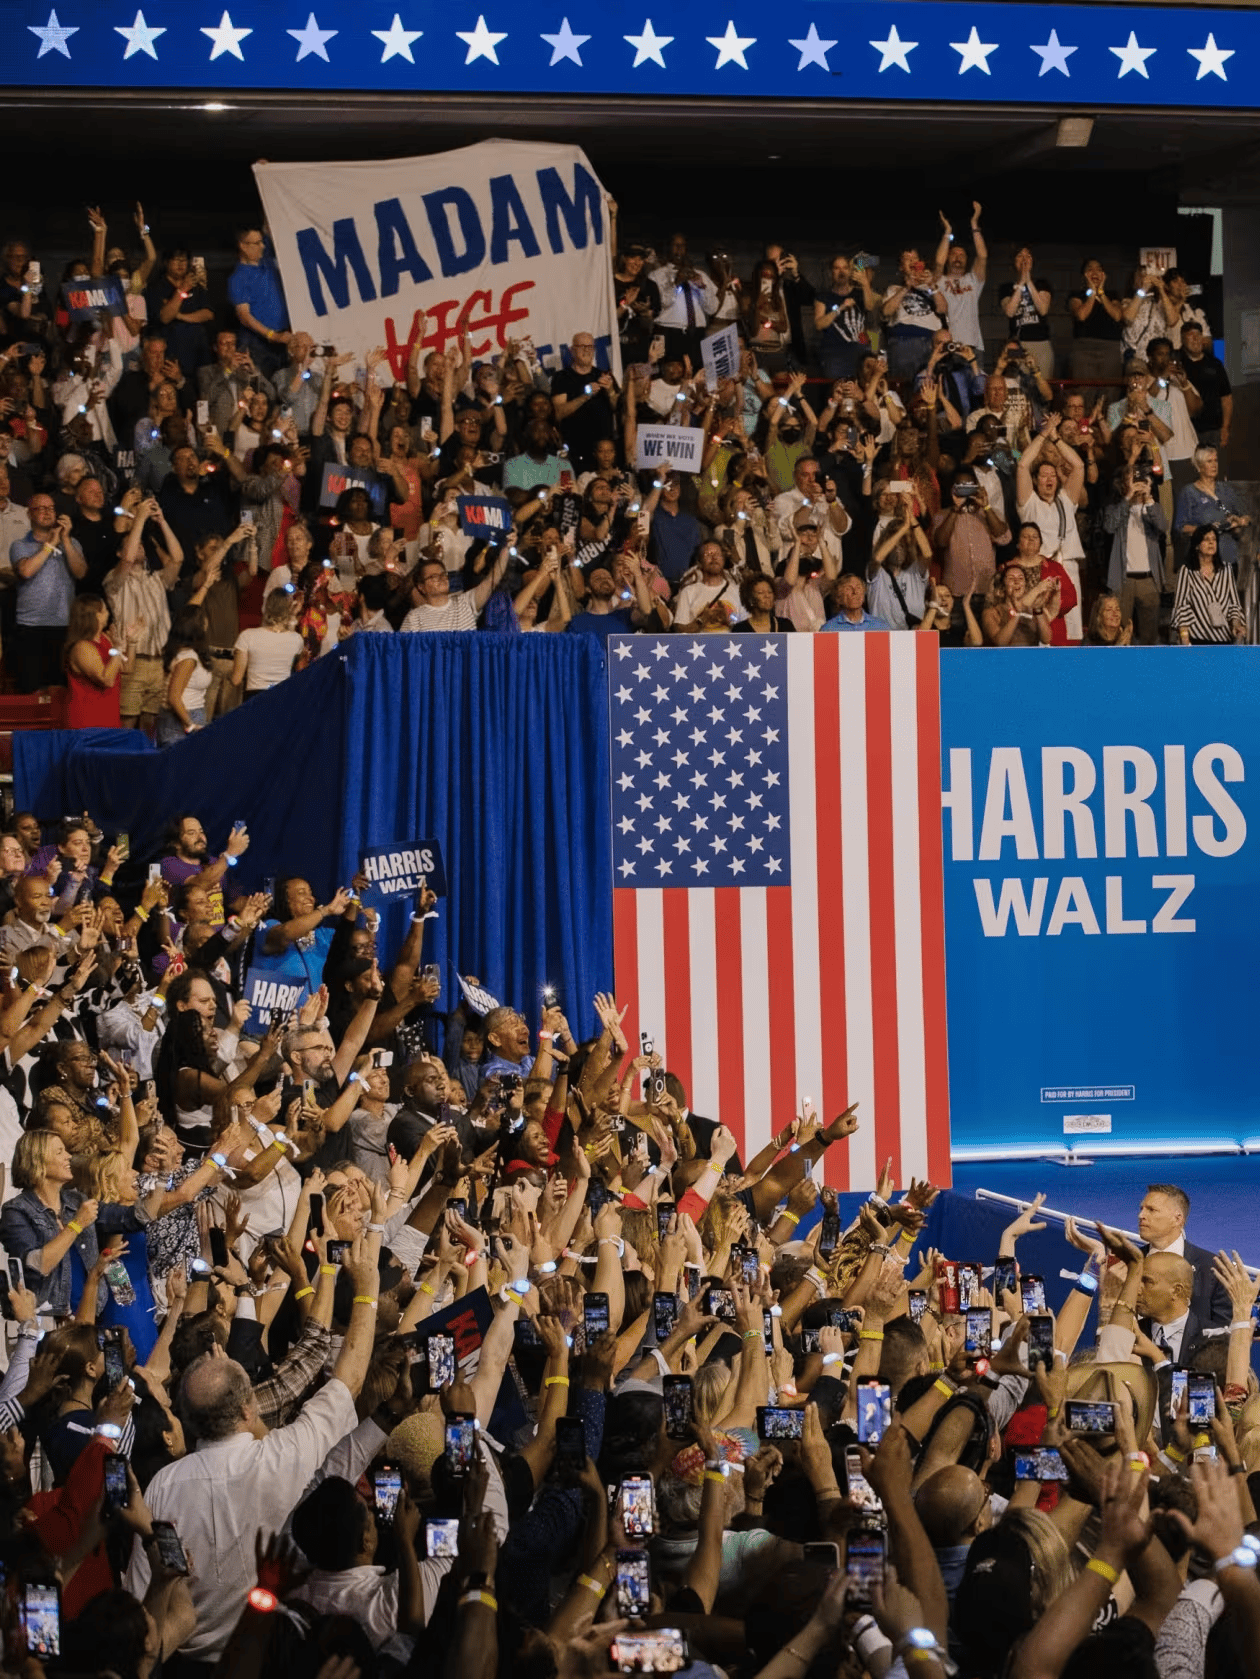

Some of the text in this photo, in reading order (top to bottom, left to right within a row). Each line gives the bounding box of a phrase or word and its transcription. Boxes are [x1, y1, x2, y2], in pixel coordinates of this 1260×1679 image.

[296, 163, 603, 317] MADAM
[644, 439, 695, 460] WE WIN
[941, 742, 1247, 861] HARRIS
[364, 849, 435, 881] HARRIS
[379, 874, 427, 894] WALZ
[973, 874, 1196, 937] WALZ
[251, 980, 304, 1012] HARR
[1044, 1091, 1057, 1099] PAID
[1067, 1090, 1075, 1098] BY
[1075, 1090, 1094, 1098] HARRIS
[1094, 1089, 1104, 1097] FOR
[1104, 1089, 1131, 1097] PRESIDENT
